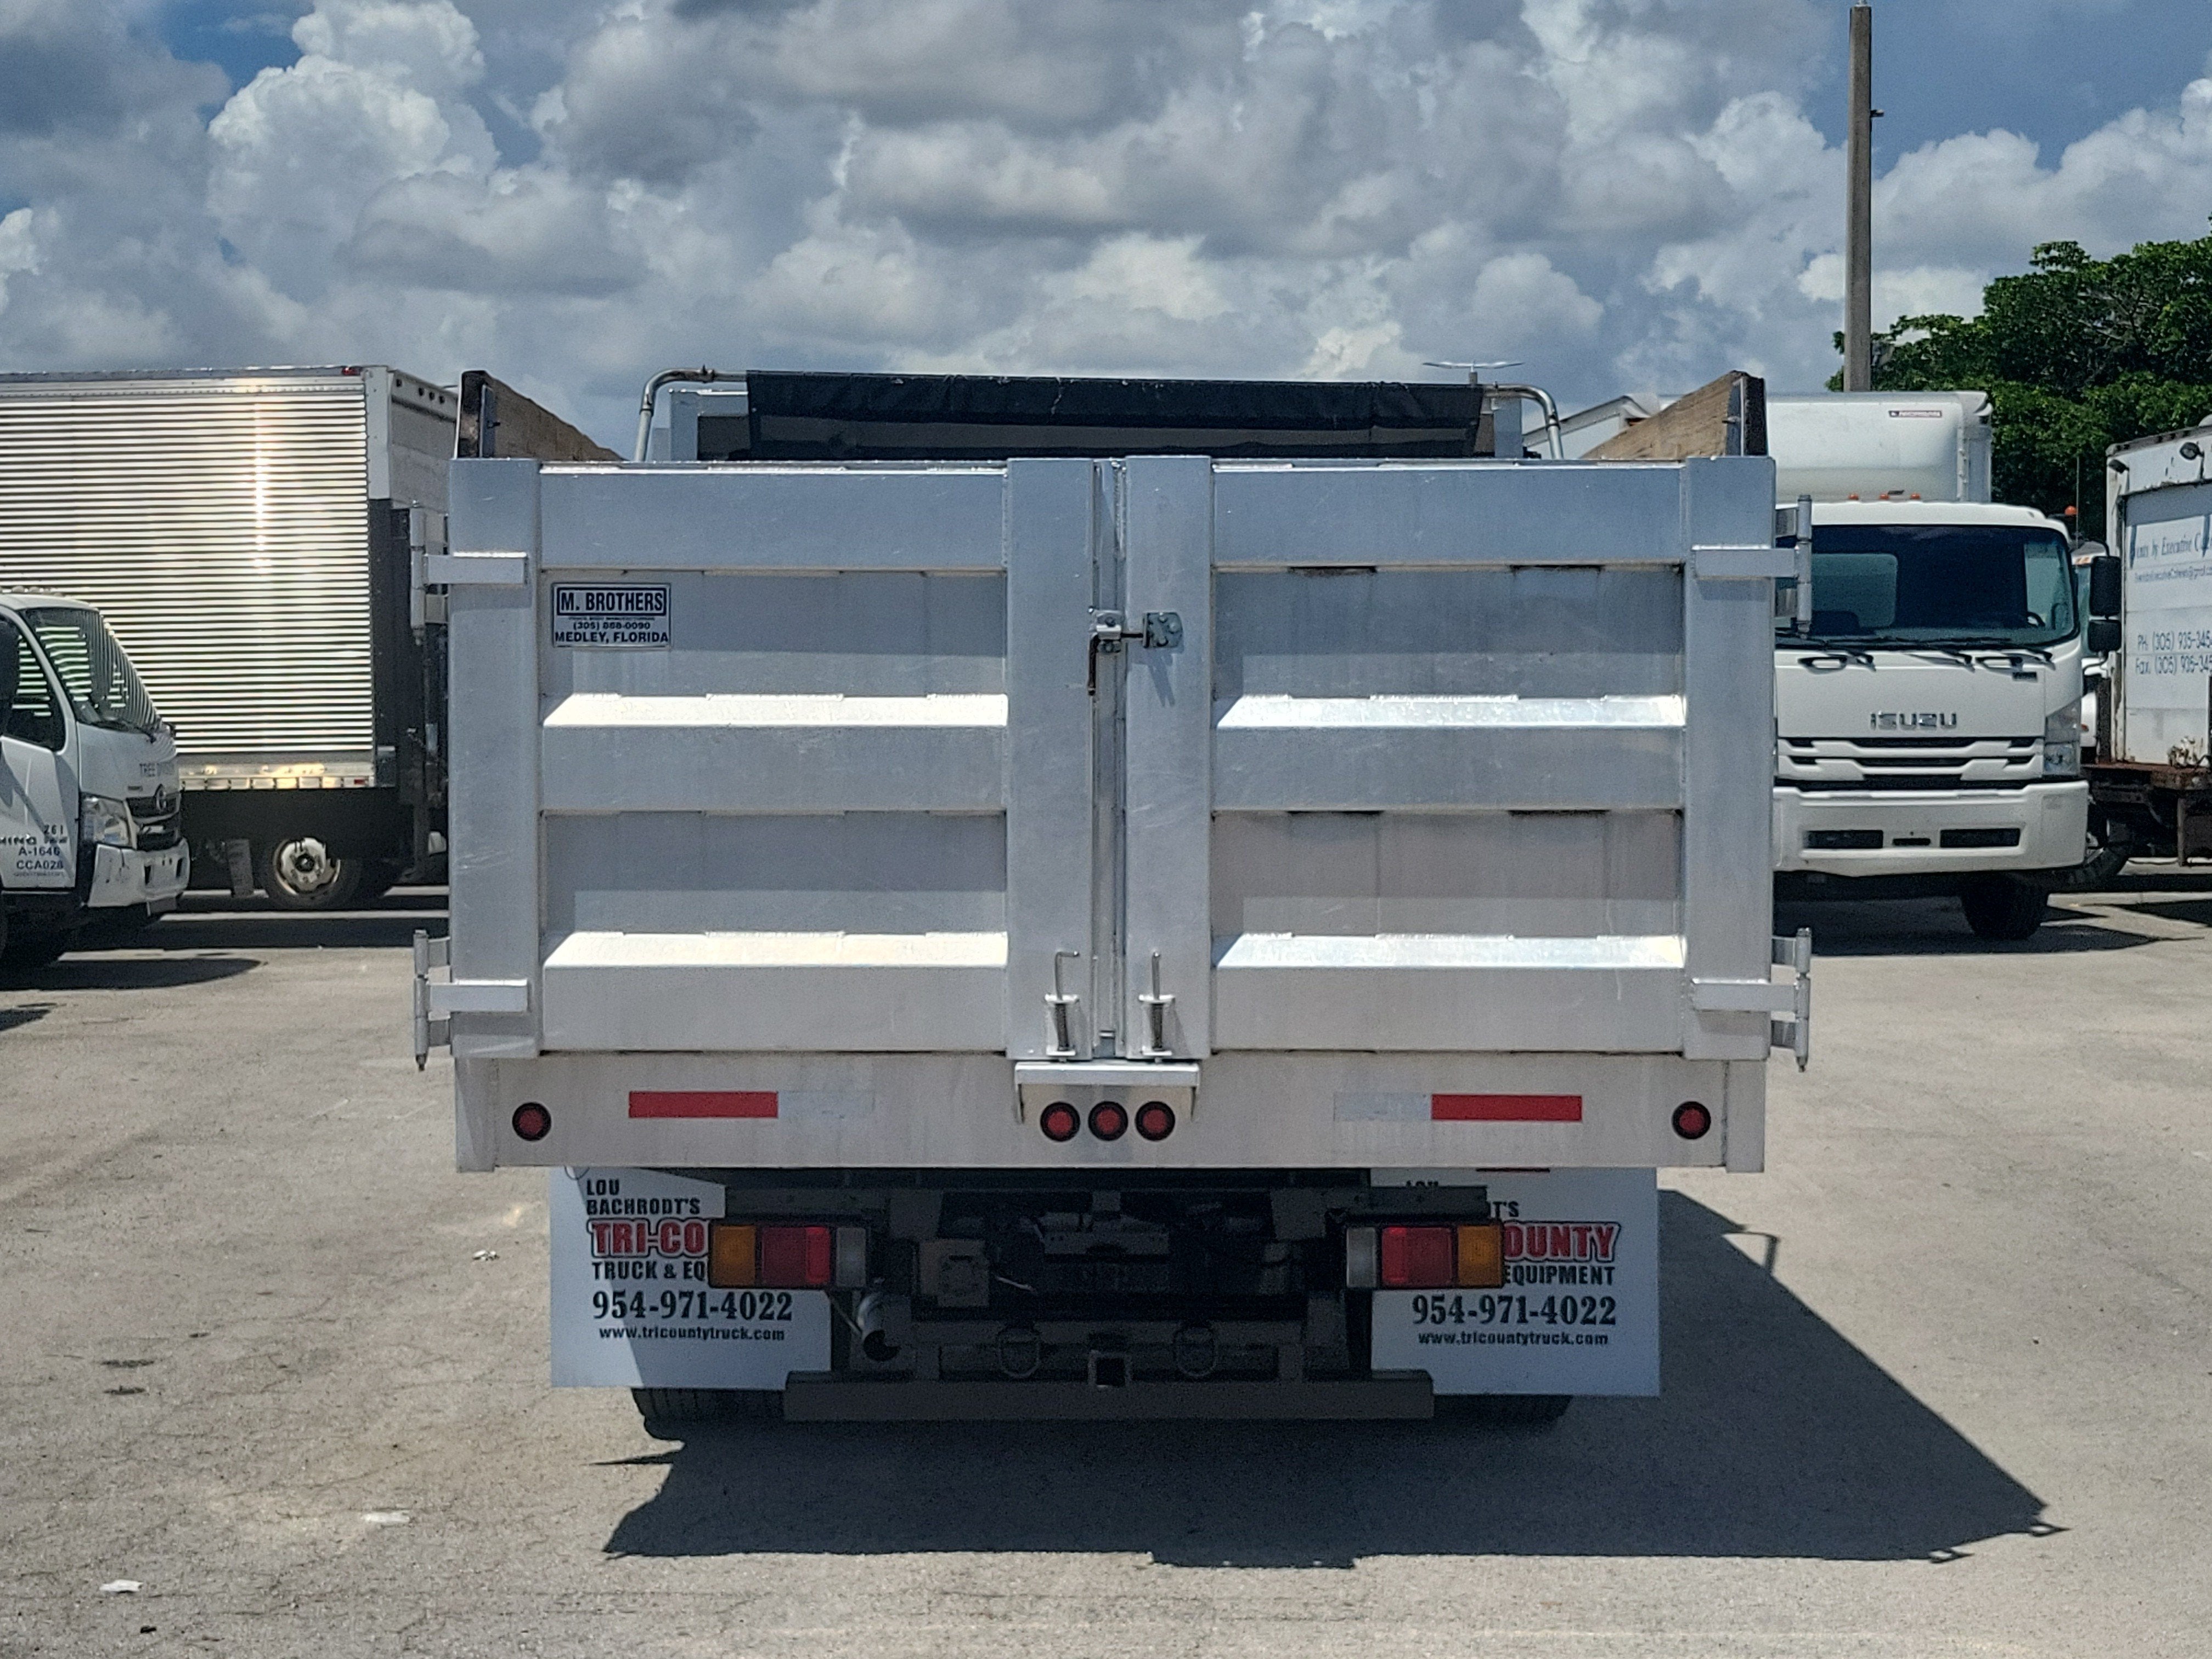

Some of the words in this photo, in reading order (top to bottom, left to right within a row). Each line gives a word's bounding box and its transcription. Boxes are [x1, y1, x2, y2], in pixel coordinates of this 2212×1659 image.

[561, 592, 580, 611] M.
[585, 592, 663, 611] BROTHERS
[555, 631, 610, 644] MEDLEY,
[613, 631, 669, 642] FLORIDA
[1870, 712, 1957, 730] ISUZU
[586, 1178, 620, 1196] LOU
[586, 1197, 701, 1216] BACHRODT'S
[589, 1220, 708, 1256] TRI-CO
[1504, 1222, 1618, 1260] OUNTY
[591, 1261, 658, 1280] TRUCK
[664, 1263, 677, 1279] &
[1504, 1265, 1615, 1286] EQUIPMENT
[592, 1290, 793, 1321] 954-971-4022
[1412, 1295, 1616, 1326] 954-971-4022
[599, 1325, 785, 1341] www.tricountytruck.com
[1418, 1330, 1609, 1346] www.tricountytruck.com
